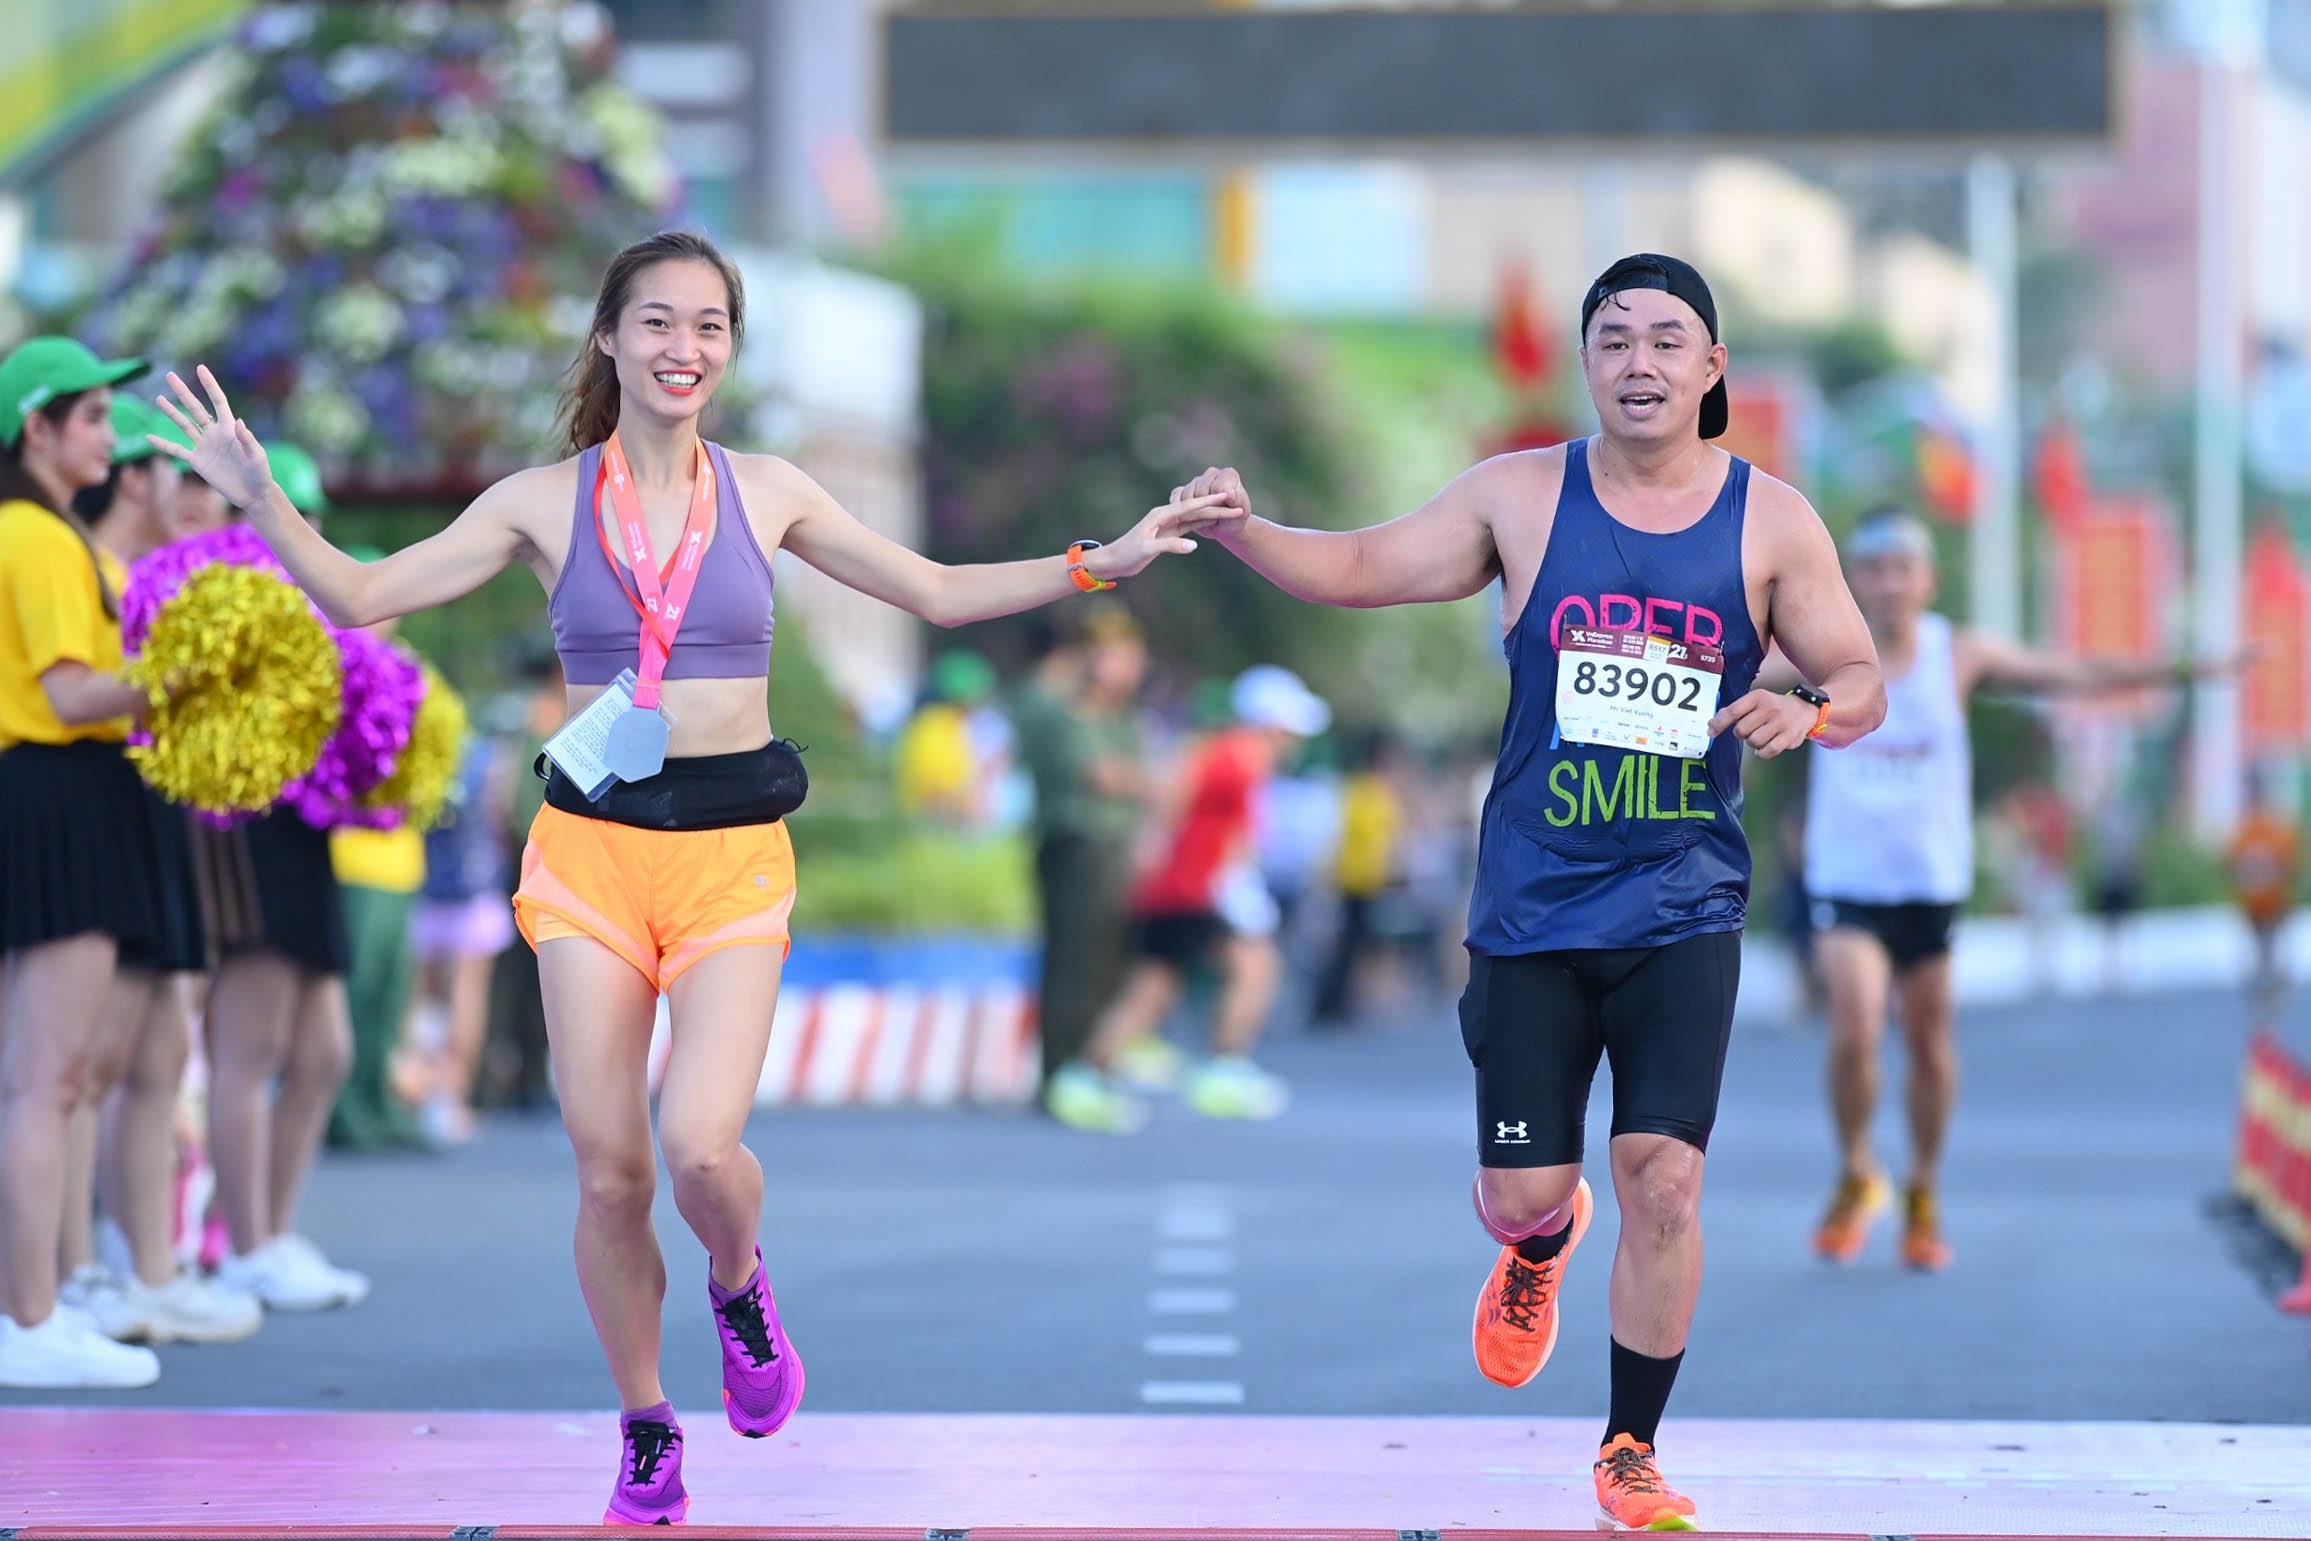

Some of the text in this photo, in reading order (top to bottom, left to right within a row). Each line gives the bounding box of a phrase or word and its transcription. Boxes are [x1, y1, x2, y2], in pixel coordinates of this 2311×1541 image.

[664, 602, 681, 620] 21
[1573, 661, 1701, 712] 83902
[1544, 754, 1716, 827] SMILE
